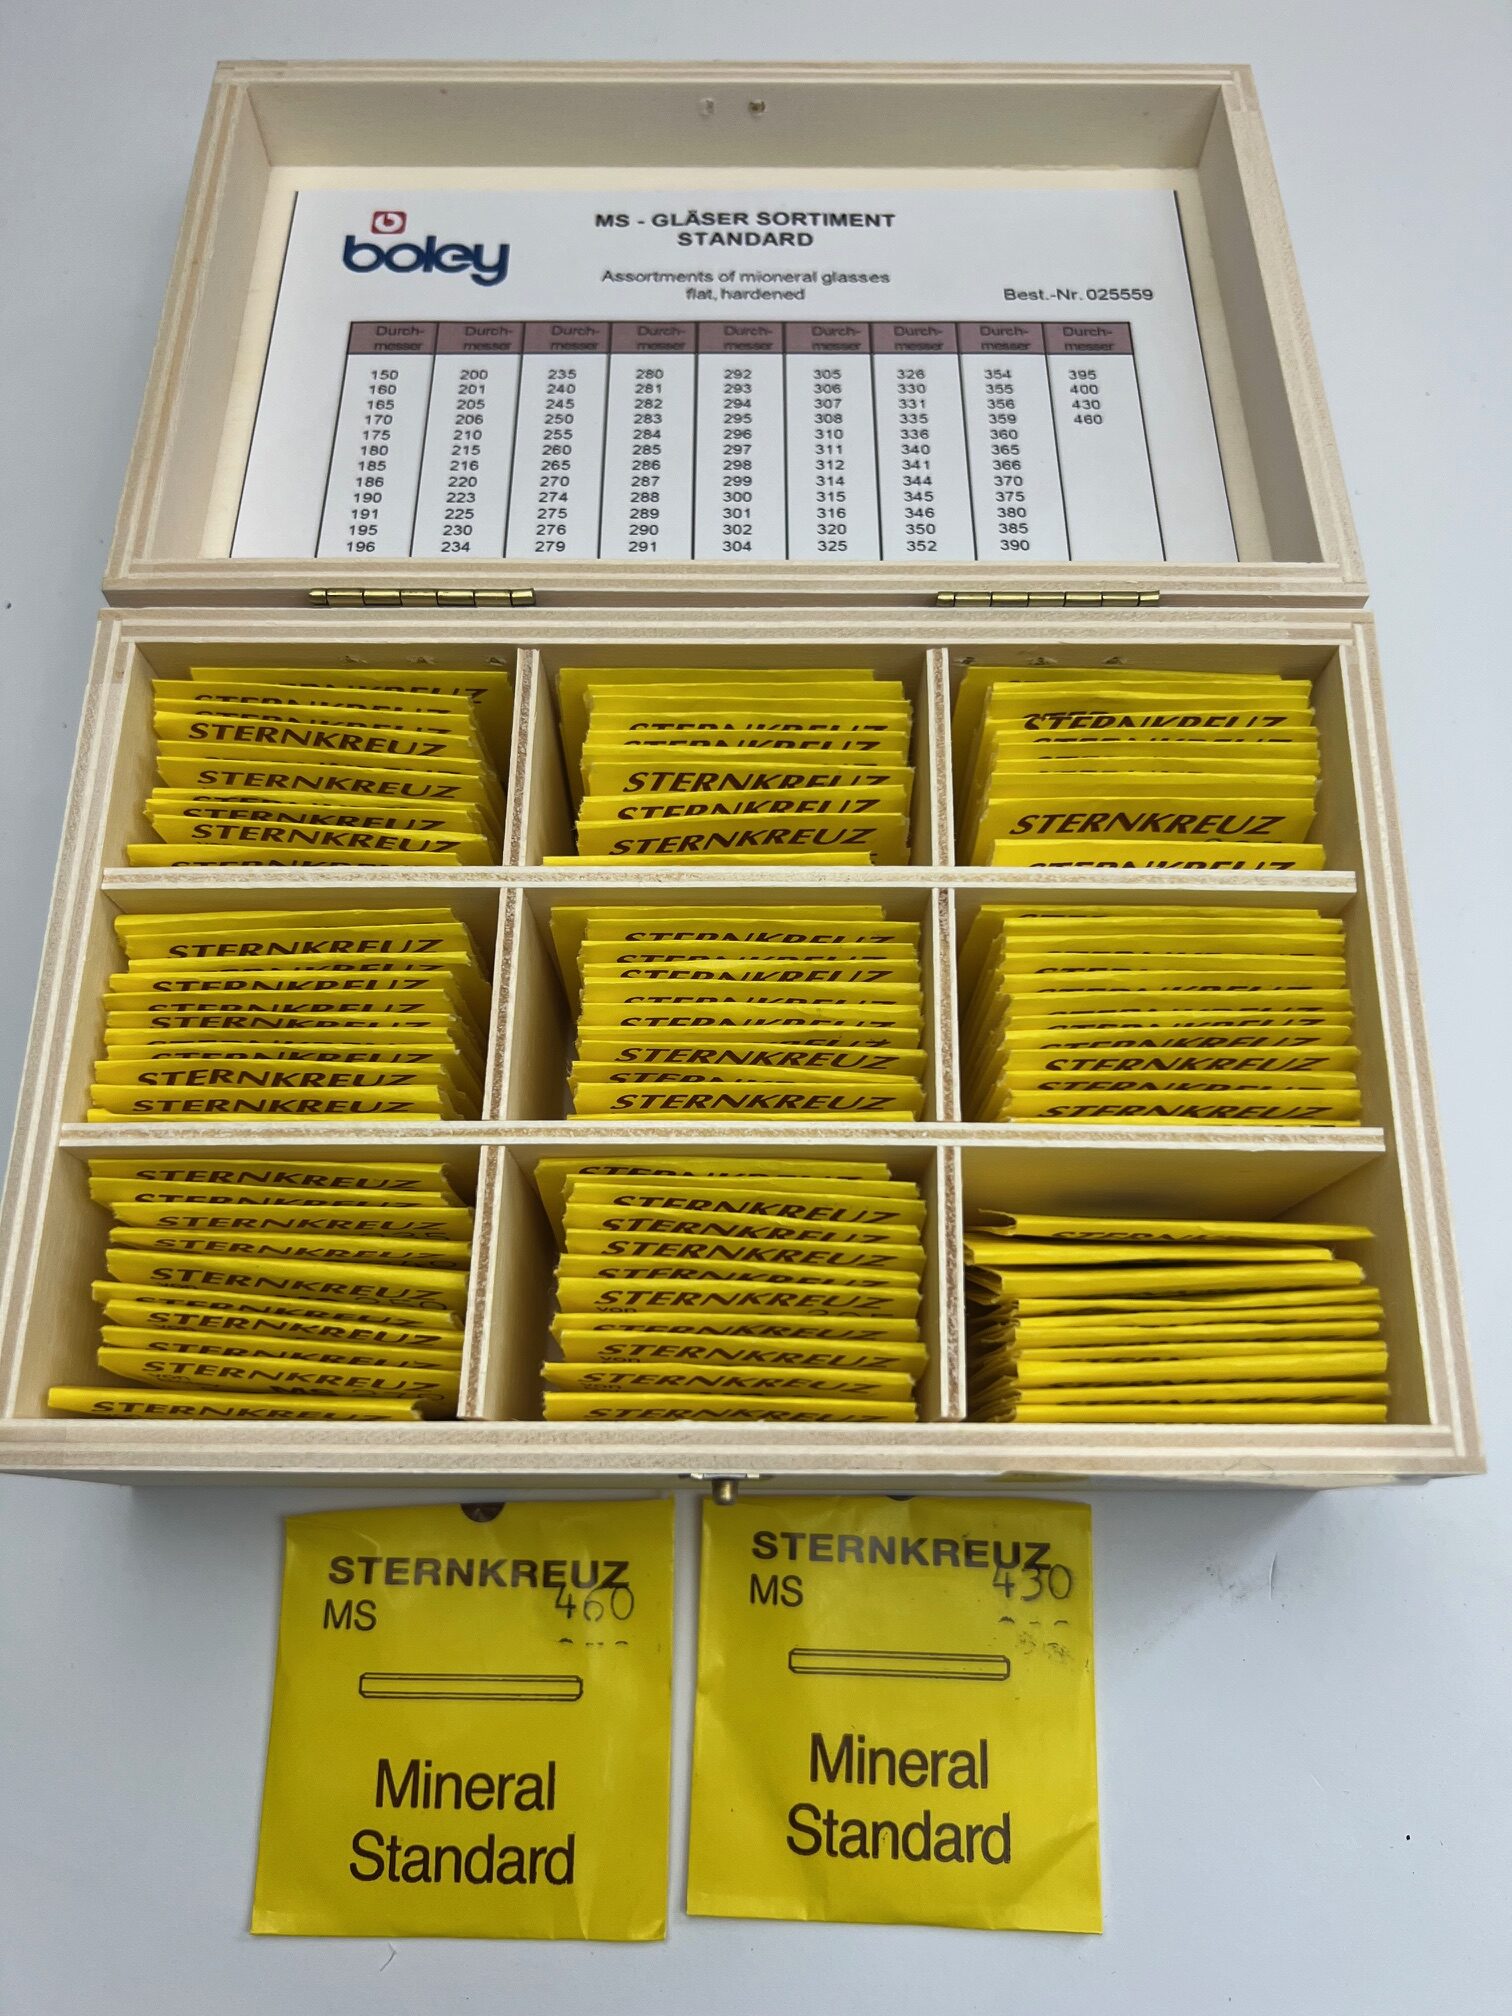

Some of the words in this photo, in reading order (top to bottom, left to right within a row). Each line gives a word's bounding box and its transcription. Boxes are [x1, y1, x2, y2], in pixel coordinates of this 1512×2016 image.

[595, 214, 629, 227] MS
[651, 210, 749, 227] GLÄSER
[756, 212, 896, 227] SORTIMENT
[677, 232, 814, 247] STANDARD
[343, 235, 510, 287] boley
[602, 271, 714, 284] Assortments
[718, 270, 735, 283] of
[739, 271, 817, 283] mioneral
[821, 272, 890, 286] glasses
[686, 288, 717, 301] flat,
[721, 288, 806, 300] hardened
[1004, 289, 1082, 300] Best.-Nr.
[1086, 289, 1153, 300] 025559
[371, 369, 399, 380] 150
[459, 369, 488, 380] 200
[547, 369, 577, 380] 235
[635, 368, 664, 379] 280
[723, 368, 752, 379] 292
[813, 369, 842, 379] 305
[897, 368, 926, 379] 326
[984, 369, 1012, 379] 354
[1069, 369, 1097, 380] 395
[369, 384, 397, 395] 160
[457, 383, 485, 395] 201
[546, 383, 576, 394] 240
[634, 383, 662, 394] 281
[723, 383, 752, 394] 293
[813, 383, 842, 394] 306
[897, 383, 927, 394] 330
[986, 383, 1014, 394] 355
[1070, 384, 1099, 395] 400
[367, 399, 394, 410] 165
[456, 399, 485, 410] 205
[545, 398, 575, 409] 245
[634, 398, 663, 409] 282
[723, 398, 752, 409] 294
[814, 397, 842, 409] 307
[898, 397, 926, 409] 331
[987, 398, 1016, 409] 356
[1072, 399, 1101, 410] 430
[365, 414, 393, 425] 170
[455, 414, 483, 425] 206
[544, 413, 574, 424] 250
[633, 413, 662, 424] 283
[723, 413, 752, 424] 295
[814, 413, 843, 424] 308
[899, 413, 929, 424] 335
[988, 413, 1017, 424] 359
[1074, 414, 1104, 425] 460
[363, 429, 390, 441] 175
[453, 429, 482, 440] 210
[543, 429, 573, 440] 255
[633, 429, 661, 440] 284
[723, 429, 752, 439] 296
[814, 429, 844, 439] 310
[900, 428, 930, 439] 336
[990, 428, 1019, 440] 360
[360, 445, 388, 456] 180
[451, 443, 481, 456] 215
[542, 444, 572, 455] 260
[632, 444, 662, 455] 285
[723, 443, 752, 455] 297
[815, 443, 842, 455] 311
[901, 443, 931, 455] 340
[991, 444, 1021, 455] 365
[358, 460, 386, 471] 185
[449, 460, 479, 471] 216
[540, 460, 571, 471] 265
[631, 459, 661, 471] 286
[723, 459, 752, 470] 298
[815, 459, 845, 470] 312
[902, 459, 930, 470] 341
[993, 459, 1022, 470] 366
[356, 476, 384, 487] 186
[448, 476, 477, 487] 220
[539, 475, 570, 487] 270
[631, 475, 660, 487] 287
[723, 475, 752, 487] 299
[816, 475, 845, 486] 314
[903, 475, 933, 486] 344
[994, 475, 1024, 486] 370
[353, 492, 382, 503] 190
[446, 492, 475, 503] 223
[538, 491, 568, 503] 274
[630, 491, 660, 503] 288
[723, 491, 752, 502] 300
[816, 491, 846, 502] 315
[904, 491, 934, 502] 345
[995, 491, 1025, 502] 375
[351, 508, 378, 519] 191
[444, 508, 474, 520] 225
[537, 508, 567, 519] 275
[629, 508, 660, 519] 289
[723, 507, 750, 519] 301
[817, 507, 846, 518] 316
[905, 507, 935, 518] 346
[997, 507, 1027, 518] 380
[349, 524, 378, 536] 195
[442, 524, 473, 536] 230
[536, 524, 566, 535] 276
[629, 524, 659, 535] 290
[722, 523, 752, 535] 302
[817, 523, 847, 535] 320
[905, 523, 936, 535] 350
[998, 523, 1029, 534] 385
[347, 541, 375, 552] 196
[441, 541, 471, 552] 234
[535, 541, 565, 552] 279
[628, 541, 656, 552] 291
[722, 540, 752, 552] 304
[817, 540, 848, 551] 325
[906, 539, 938, 552] 352
[1000, 539, 1031, 551] 390
[188, 722, 448, 757] STERNKREUZ
[197, 770, 463, 799] STERNKREUZ
[1009, 812, 1287, 835] STERNKREUZ
[192, 824, 463, 853] STERNKREUZ
[609, 828, 878, 856] STERNKREUZ
[614, 1047, 900, 1070] STERNKREUZ
[138, 1068, 417, 1087] STERNKREUZ
[132, 1099, 416, 1113] STERNKREUZ
[610, 1093, 896, 1111] STERNKREUZ
[157, 1216, 448, 1231] STERNKREUZ
[601, 1240, 899, 1267] STERNKREUZ
[151, 1267, 443, 1300] STERNKREUZ
[594, 1290, 894, 1309] STERNKREUZ
[147, 1311, 442, 1346] STERNKREUZ
[598, 1343, 901, 1368] STERNKREUZ
[141, 1360, 440, 1392] STERNKREUZ
[578, 1372, 882, 1394] STERNKREUZ
[752, 1531, 1051, 1570] STERNKREUZ
[328, 1556, 630, 1588] STERNKREUZ
[992, 1562, 1072, 1601] 430
[750, 1573, 804, 1607] MS
[554, 1584, 634, 1622] 460
[323, 1599, 377, 1631] MS
[810, 1733, 988, 1789] Mineral
[375, 1758, 555, 1811] Mineral
[786, 1802, 1011, 1864] Standard
[349, 1829, 575, 1885] Standard
